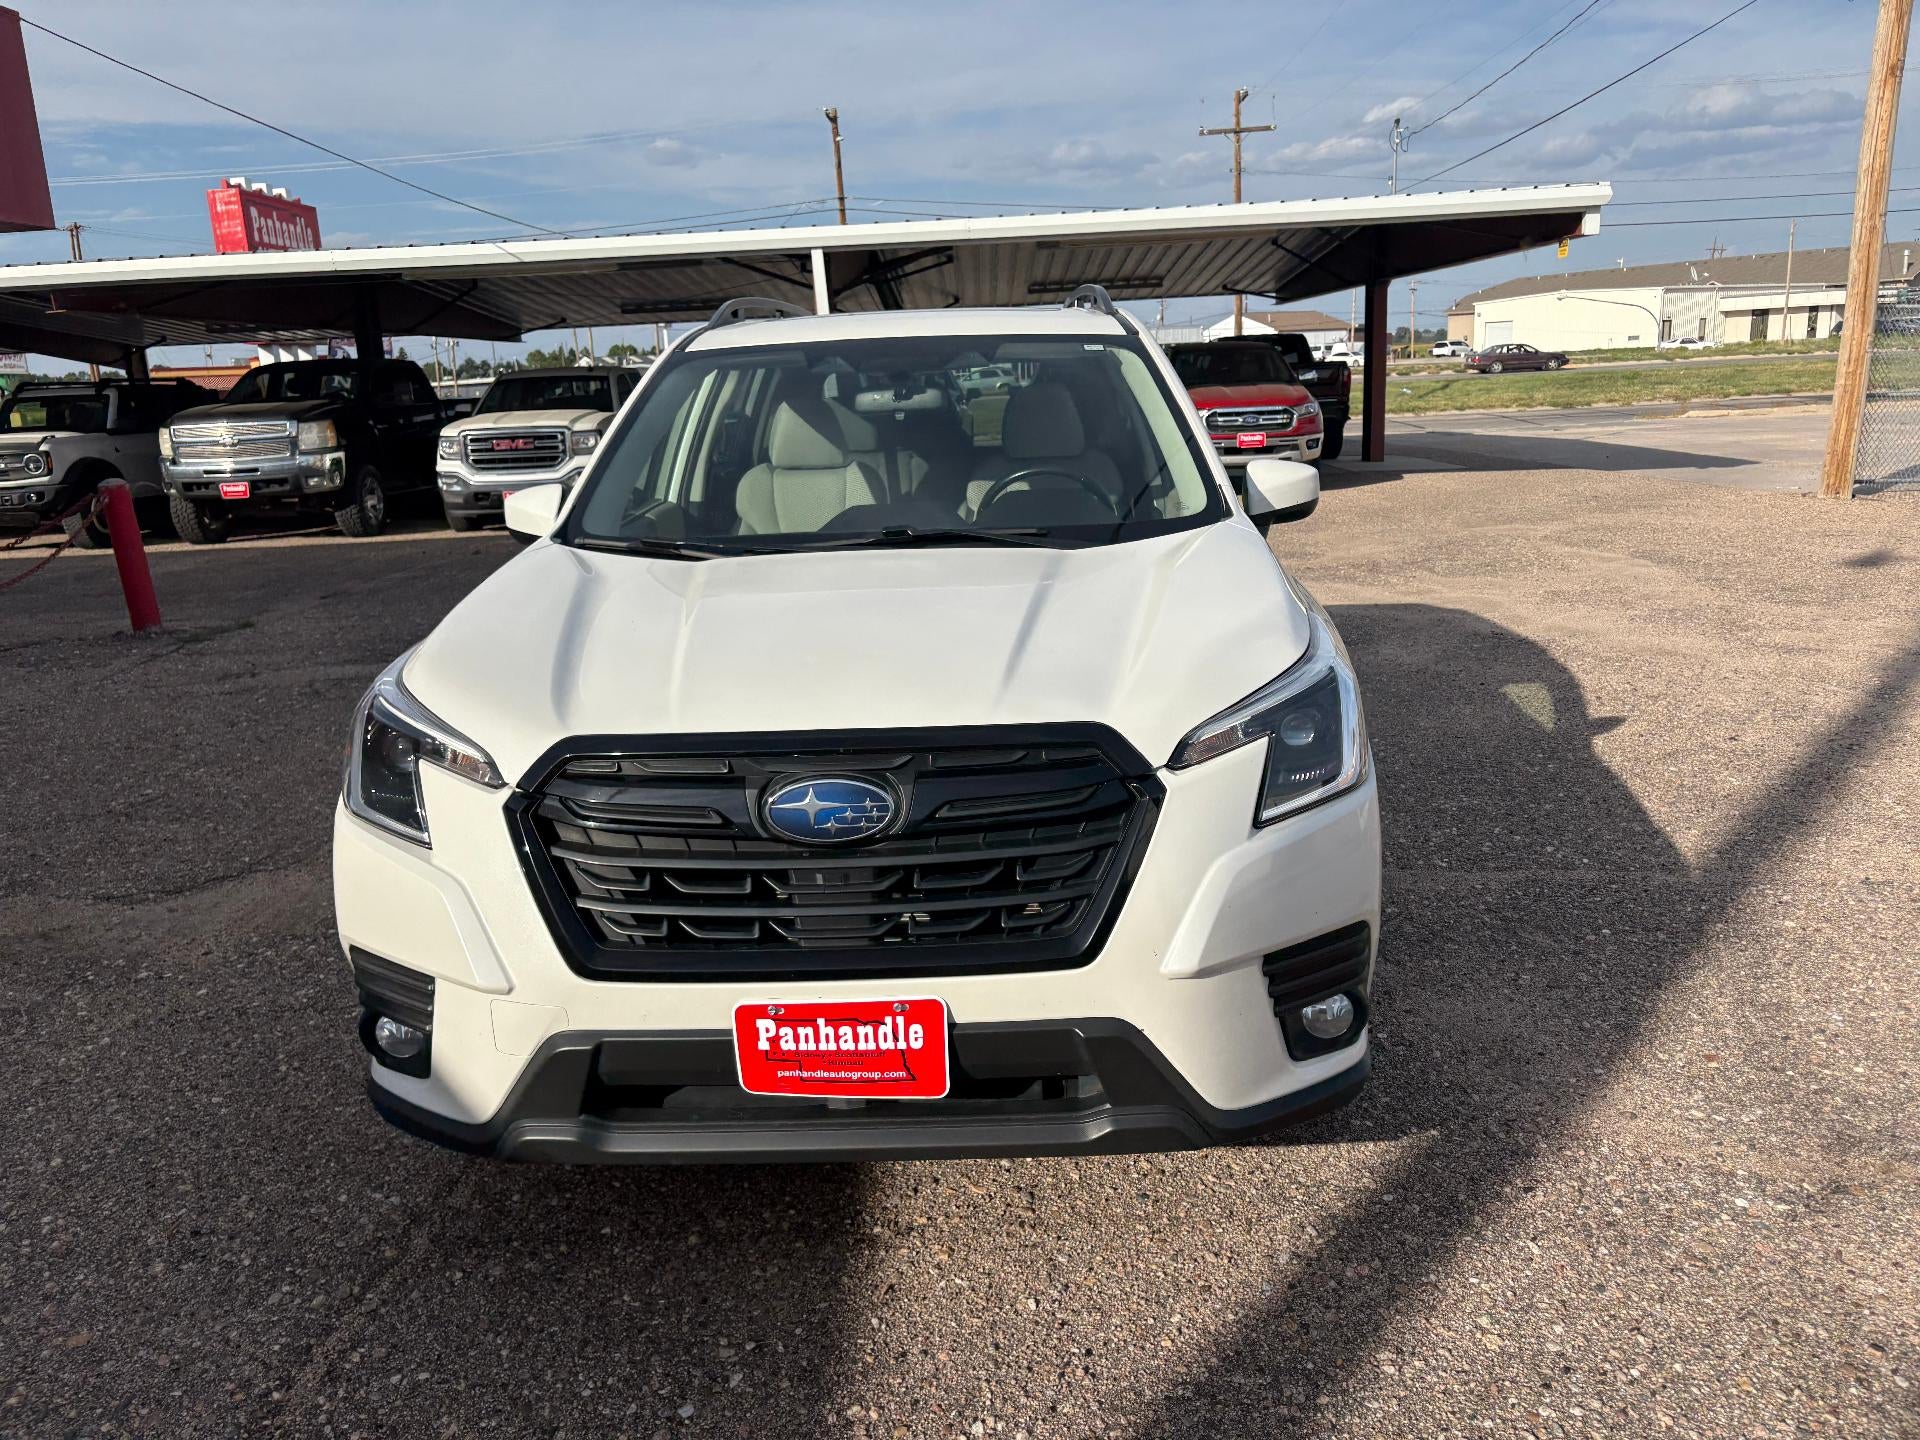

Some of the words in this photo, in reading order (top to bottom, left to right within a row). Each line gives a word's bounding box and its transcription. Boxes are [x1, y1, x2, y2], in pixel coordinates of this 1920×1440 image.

[250, 206, 314, 249] Panhandle
[493, 438, 534, 450] GMC
[755, 1015, 924, 1051] Panhandle
[795, 1051, 826, 1059] Sidney
[777, 1069, 906, 1079] panhandleautogroup.com
